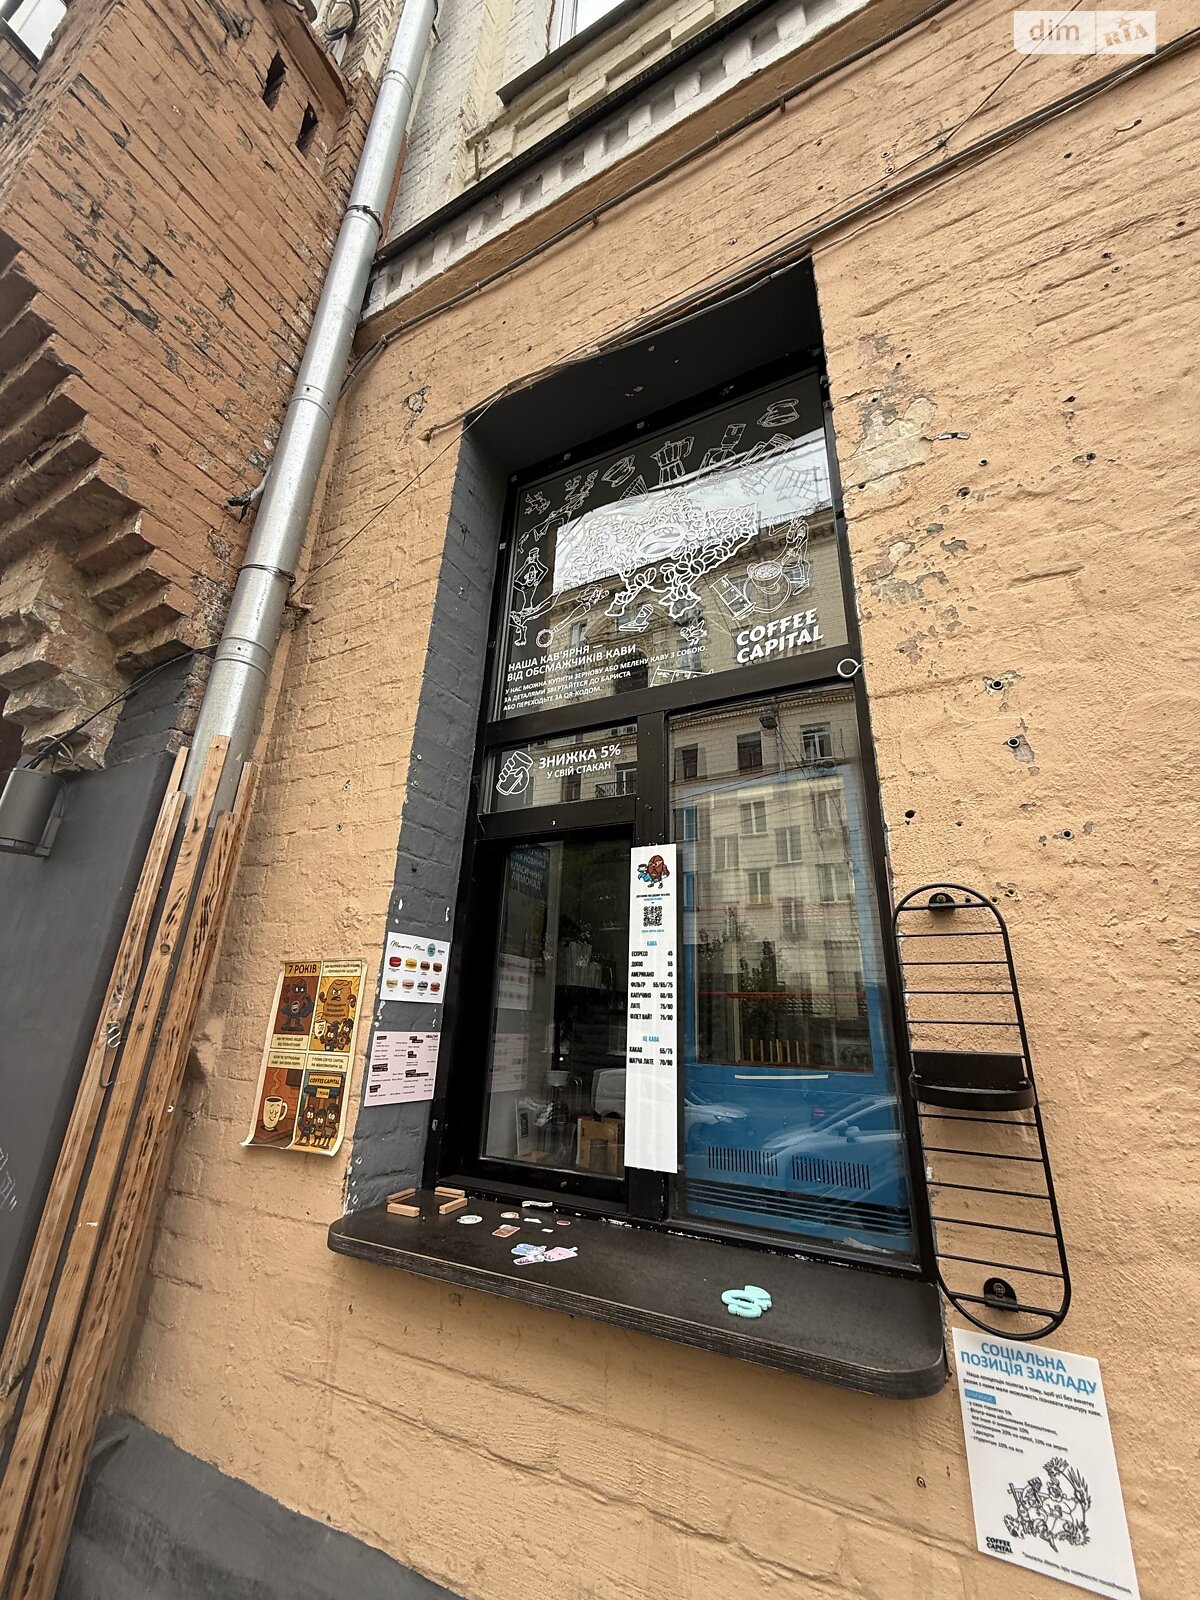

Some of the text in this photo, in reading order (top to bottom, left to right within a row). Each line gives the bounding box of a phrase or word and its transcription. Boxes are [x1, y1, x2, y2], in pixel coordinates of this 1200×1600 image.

[736, 608, 818, 646] COFFEE
[508, 659, 538, 672] НАША
[540, 645, 590, 663] КАВ'ЯРНЯ
[737, 627, 824, 664] CAPITAL
[507, 643, 637, 682] ВІД ОБСМАЖЧИКІВ КАВИ
[510, 685, 522, 693] НАС
[523, 681, 547, 691] МОЖНА
[547, 675, 574, 687] КУПИТИ
[575, 669, 603, 681] ЗЕРНОВУ
[604, 665, 619, 673] АБО
[619, 658, 649, 670] МЕЛЕНУ
[650, 654, 669, 663] КАВУ
[676, 646, 708, 658] СОБОЮ.
[504, 670, 631, 704] ЗА ДЕТАЛЯМИ ЗВЕРТАЙТЕСЯ ДО БАРИСТА
[503, 703, 516, 711] АБО
[516, 696, 554, 709] ПЕРЕХОДЬТЕ
[554, 693, 563, 701] ЗА
[539, 743, 621, 769] ЗНИЖКА 5%
[547, 761, 611, 780] У СВІЙ СТАКАН
[288, 965, 294, 974] 7
[294, 963, 317, 974] РОКІВ
[310, 1077, 324, 1085] COFFEE
[981, 1342, 1066, 1372] СОЦІАЛЬНА
[961, 1351, 1097, 1395] ПОЗИЦІЯ ЗАКЛАДУ
[986, 1537, 1010, 1547] COFFEE
[987, 1543, 1013, 1553] CAPITAL
